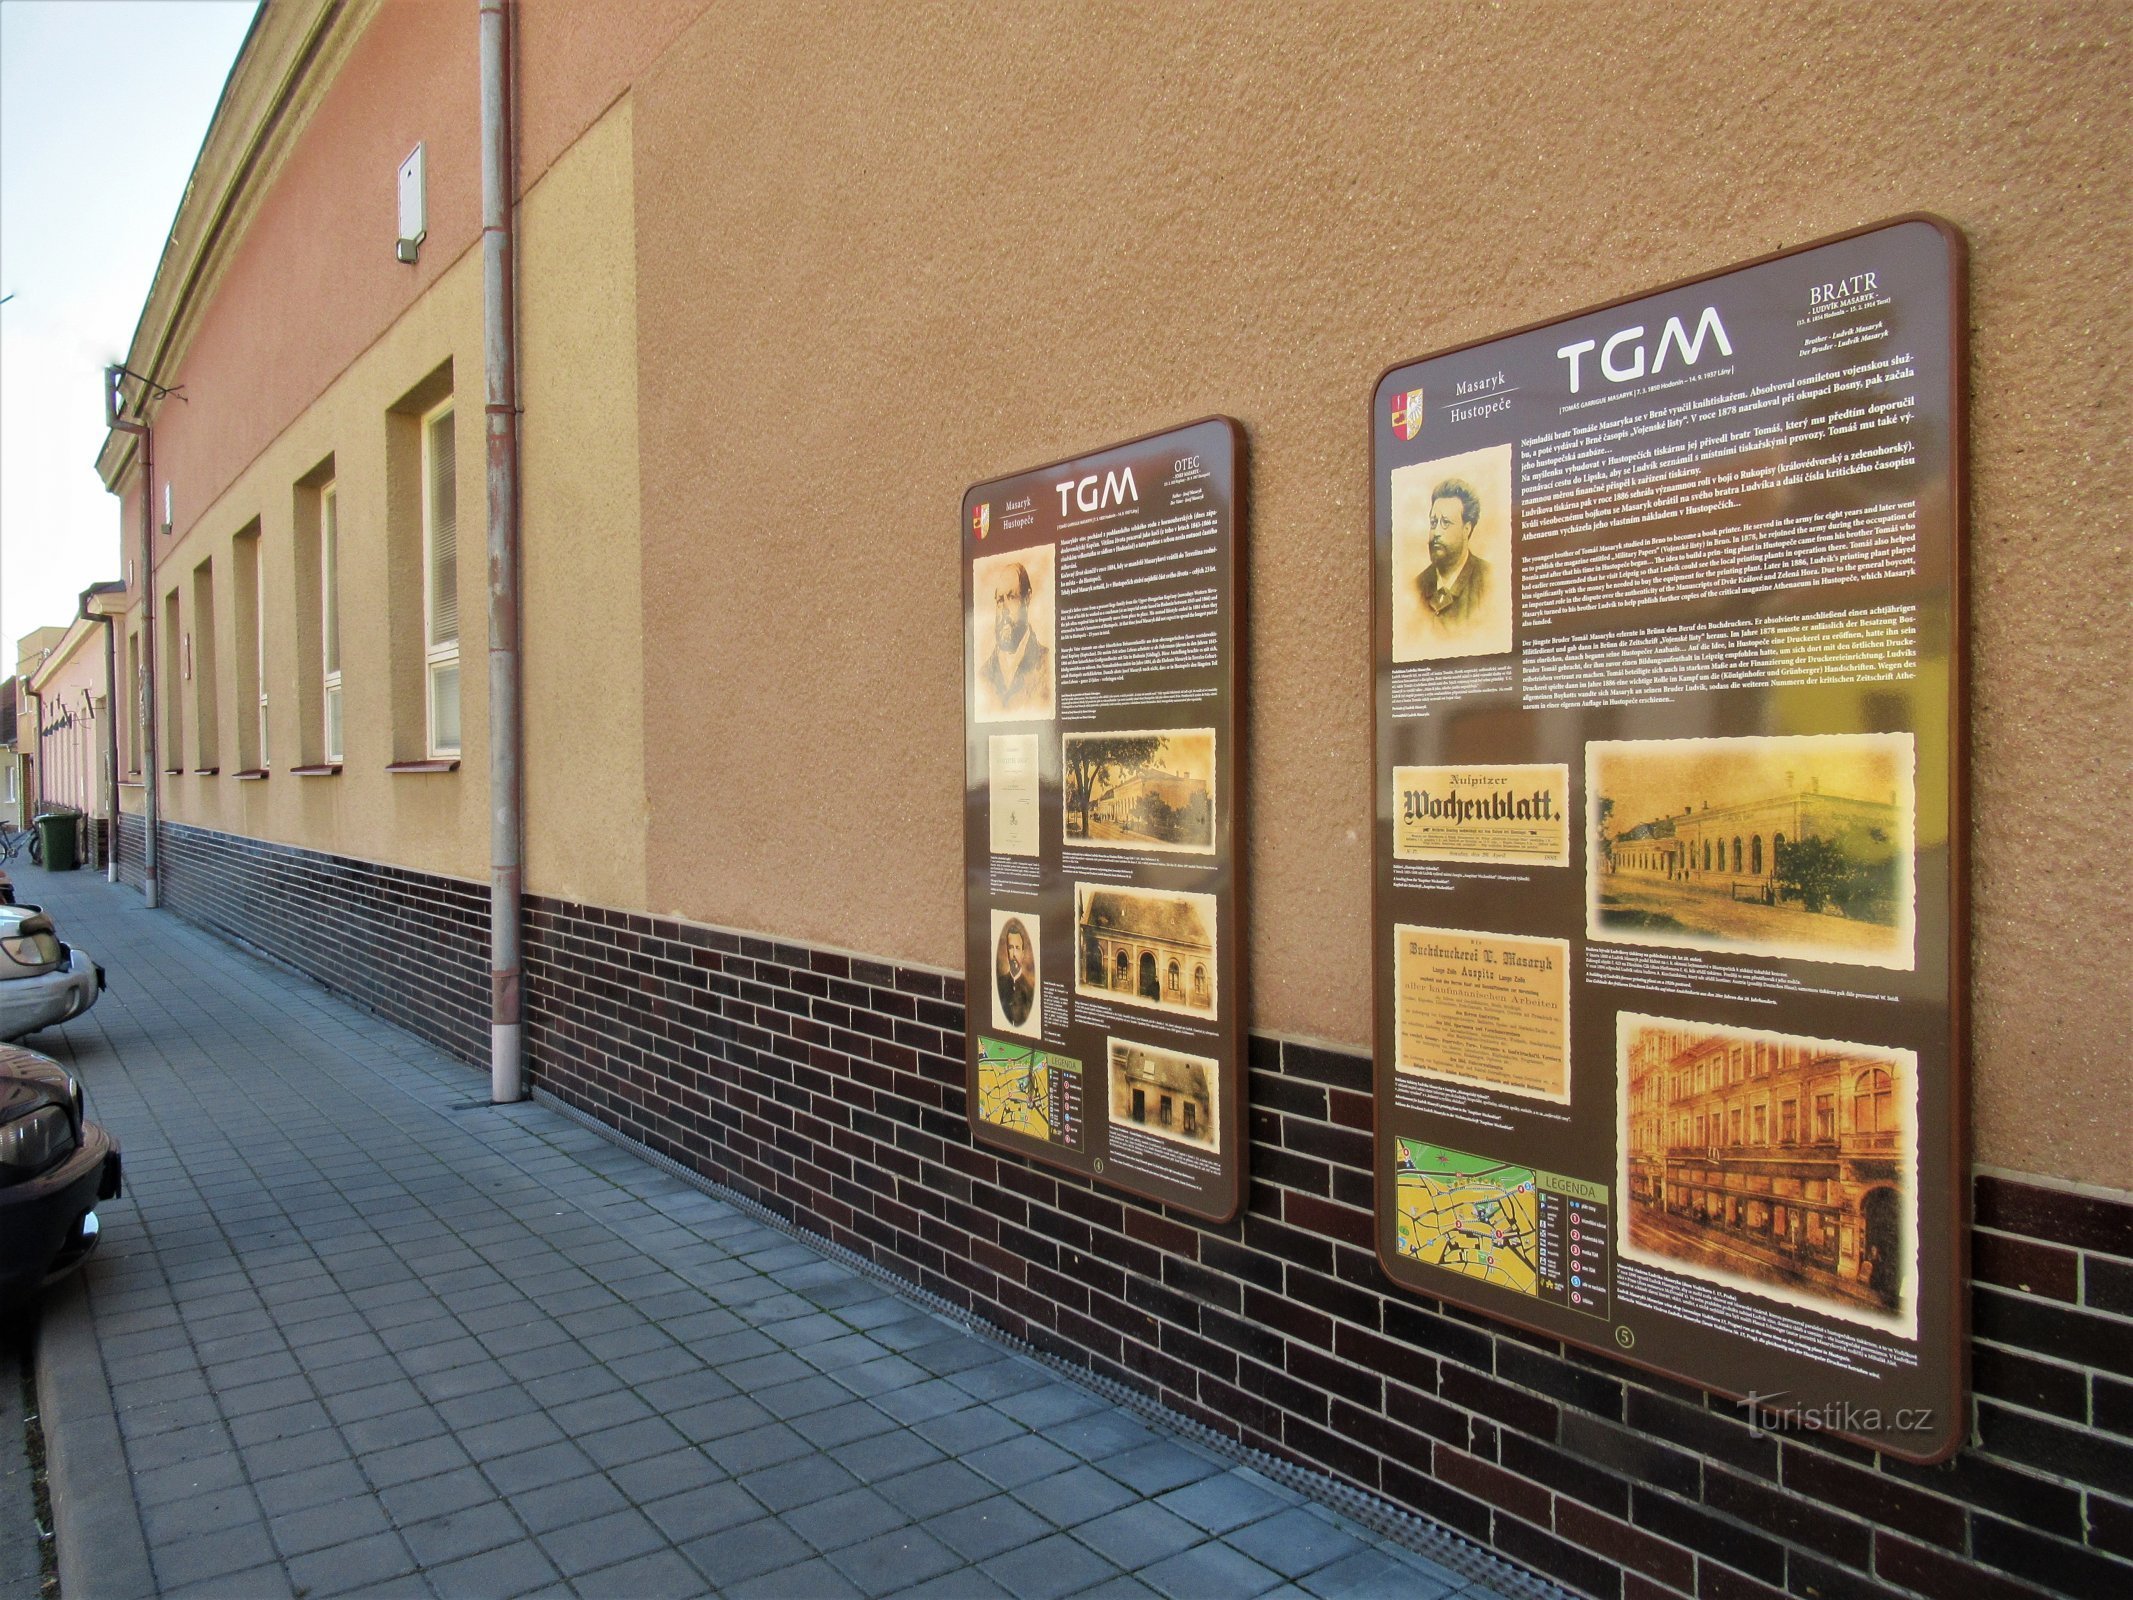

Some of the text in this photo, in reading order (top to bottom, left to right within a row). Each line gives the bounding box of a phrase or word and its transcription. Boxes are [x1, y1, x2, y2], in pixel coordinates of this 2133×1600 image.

[1810, 272, 1877, 305] BRATR
[1812, 292, 1875, 314] LUDVÍK MASARYK
[1804, 320, 1883, 345] Brother Ludvík Masaryk
[1557, 307, 1732, 393] TGM
[1456, 371, 1505, 395] Masaryk
[1451, 397, 1511, 422] Hustopeče
[1521, 433, 1554, 447] Nejmladší
[1554, 430, 1572, 439] bratr
[1572, 424, 1598, 435] Tomáše
[1599, 416, 1634, 430] Masaryka
[1649, 407, 1668, 419] Brně
[1668, 401, 1692, 416] vyučil
[1693, 392, 1748, 409] knihtiskařem.
[1750, 378, 1795, 397] Absolvoval
[1796, 371, 1841, 386] osmiletou
[1842, 360, 1889, 376] vojenskou
[1891, 353, 1914, 365] služ-
[1538, 445, 1553, 457] poté
[1553, 439, 1579, 453] vydával
[1585, 434, 1602, 445] Brně
[1603, 430, 1629, 441] časopis
[1630, 420, 1666, 436] „Vojenské
[1667, 416, 1689, 427] listy“.
[1691, 414, 1697, 422] V
[1699, 412, 1716, 421] roce
[1718, 405, 1737, 417] 1878
[1738, 395, 1780, 412] narukoval
[1782, 392, 1795, 406] při
[1796, 384, 1832, 400] okupaci
[1833, 380, 1864, 392] Bosny,
[1865, 373, 1883, 388] pak
[1884, 368, 1915, 381] začala
[1521, 474, 1531, 482] Na
[1532, 468, 1563, 481] myšlenku
[1565, 460, 1600, 475] vybudovat
[1608, 449, 1652, 465] Hustopečích
[1654, 444, 1686, 456] tiskárnu
[1687, 440, 1698, 451] jej
[1700, 433, 1728, 449] přivedl
[1730, 431, 1751, 440] bratr
[1754, 423, 1783, 436] Tomáš,
[1786, 417, 1809, 430] který
[1811, 416, 1826, 425] mu
[1828, 407, 1866, 424] předtím
[1868, 396, 1915, 414] doporučil
[1174, 455, 1200, 472] OTEC
[1521, 480, 1554, 496] poznávací
[1554, 479, 1572, 487] cestu
[1573, 475, 1582, 484] do
[1583, 471, 1608, 483] Lipska,
[1609, 468, 1622, 478] aby
[1632, 461, 1658, 473] Ludvík
[1659, 453, 1693, 467] seznámil
[1700, 445, 1737, 460] místními
[1739, 435, 1788, 452] tiskařskými
[1789, 430, 1826, 445] provozy.
[1827, 422, 1858, 435] Tomáš
[1860, 421, 1875, 430] mu
[1877, 414, 1898, 426] také
[1900, 411, 1915, 424] vý-
[1521, 447, 1613, 472] jeho hustopečská anabáze...
[1056, 466, 1138, 516] TGM
[1521, 506, 1553, 517] Ludvíkova
[1554, 502, 1580, 511] tiskárna
[1580, 497, 1593, 509] pak
[1598, 496, 1613, 504] roce
[1614, 491, 1630, 501] 1886
[1630, 487, 1655, 498] sehrála
[1655, 481, 1697, 495] významnou
[1698, 476, 1711, 486] roli
[1718, 473, 1733, 483] boji
[1740, 466, 1776, 479] Rukopisy
[1777, 452, 1843, 473] (královédvorský
[1851, 441, 1915, 460] zelenohorský).
[1521, 467, 1702, 505] znamnou měrou finančně přispěl k zařízení tiskárny.
[1006, 496, 1031, 511] Masaryk
[1522, 519, 1539, 529] Kvůli
[1540, 513, 1584, 525] všeobecnému
[1585, 508, 1612, 519] bojkotu
[1621, 500, 1653, 512] Masaryk
[1653, 495, 1679, 507] obrátil
[1691, 490, 1714, 500] svého
[1714, 487, 1740, 496] bratra
[1741, 479, 1775, 492] Ludvíka
[1783, 473, 1804, 485] další
[1804, 470, 1825, 481] čísla
[1826, 463, 1873, 478] kritického
[1874, 457, 1916, 470] časopisu
[1003, 515, 1034, 529] Hustopeče
[1521, 530, 1559, 541] Athenaeum
[1560, 522, 1593, 536] vycházela
[1593, 520, 1609, 531] jeho
[1609, 515, 1641, 526] vlastním
[1642, 510, 1678, 521] nákladem
[1686, 499, 1741, 514] Hustopečích...
[1404, 790, 1561, 825] Wochenblatt.
[1503, 951, 1553, 973] Masaryk
[1511, 996, 1558, 1010] Arbeiten
[1051, 1057, 1077, 1071] LEGENDA
[1545, 1175, 1596, 1199] LEGENDA
[1619, 1329, 1629, 1343] 5
